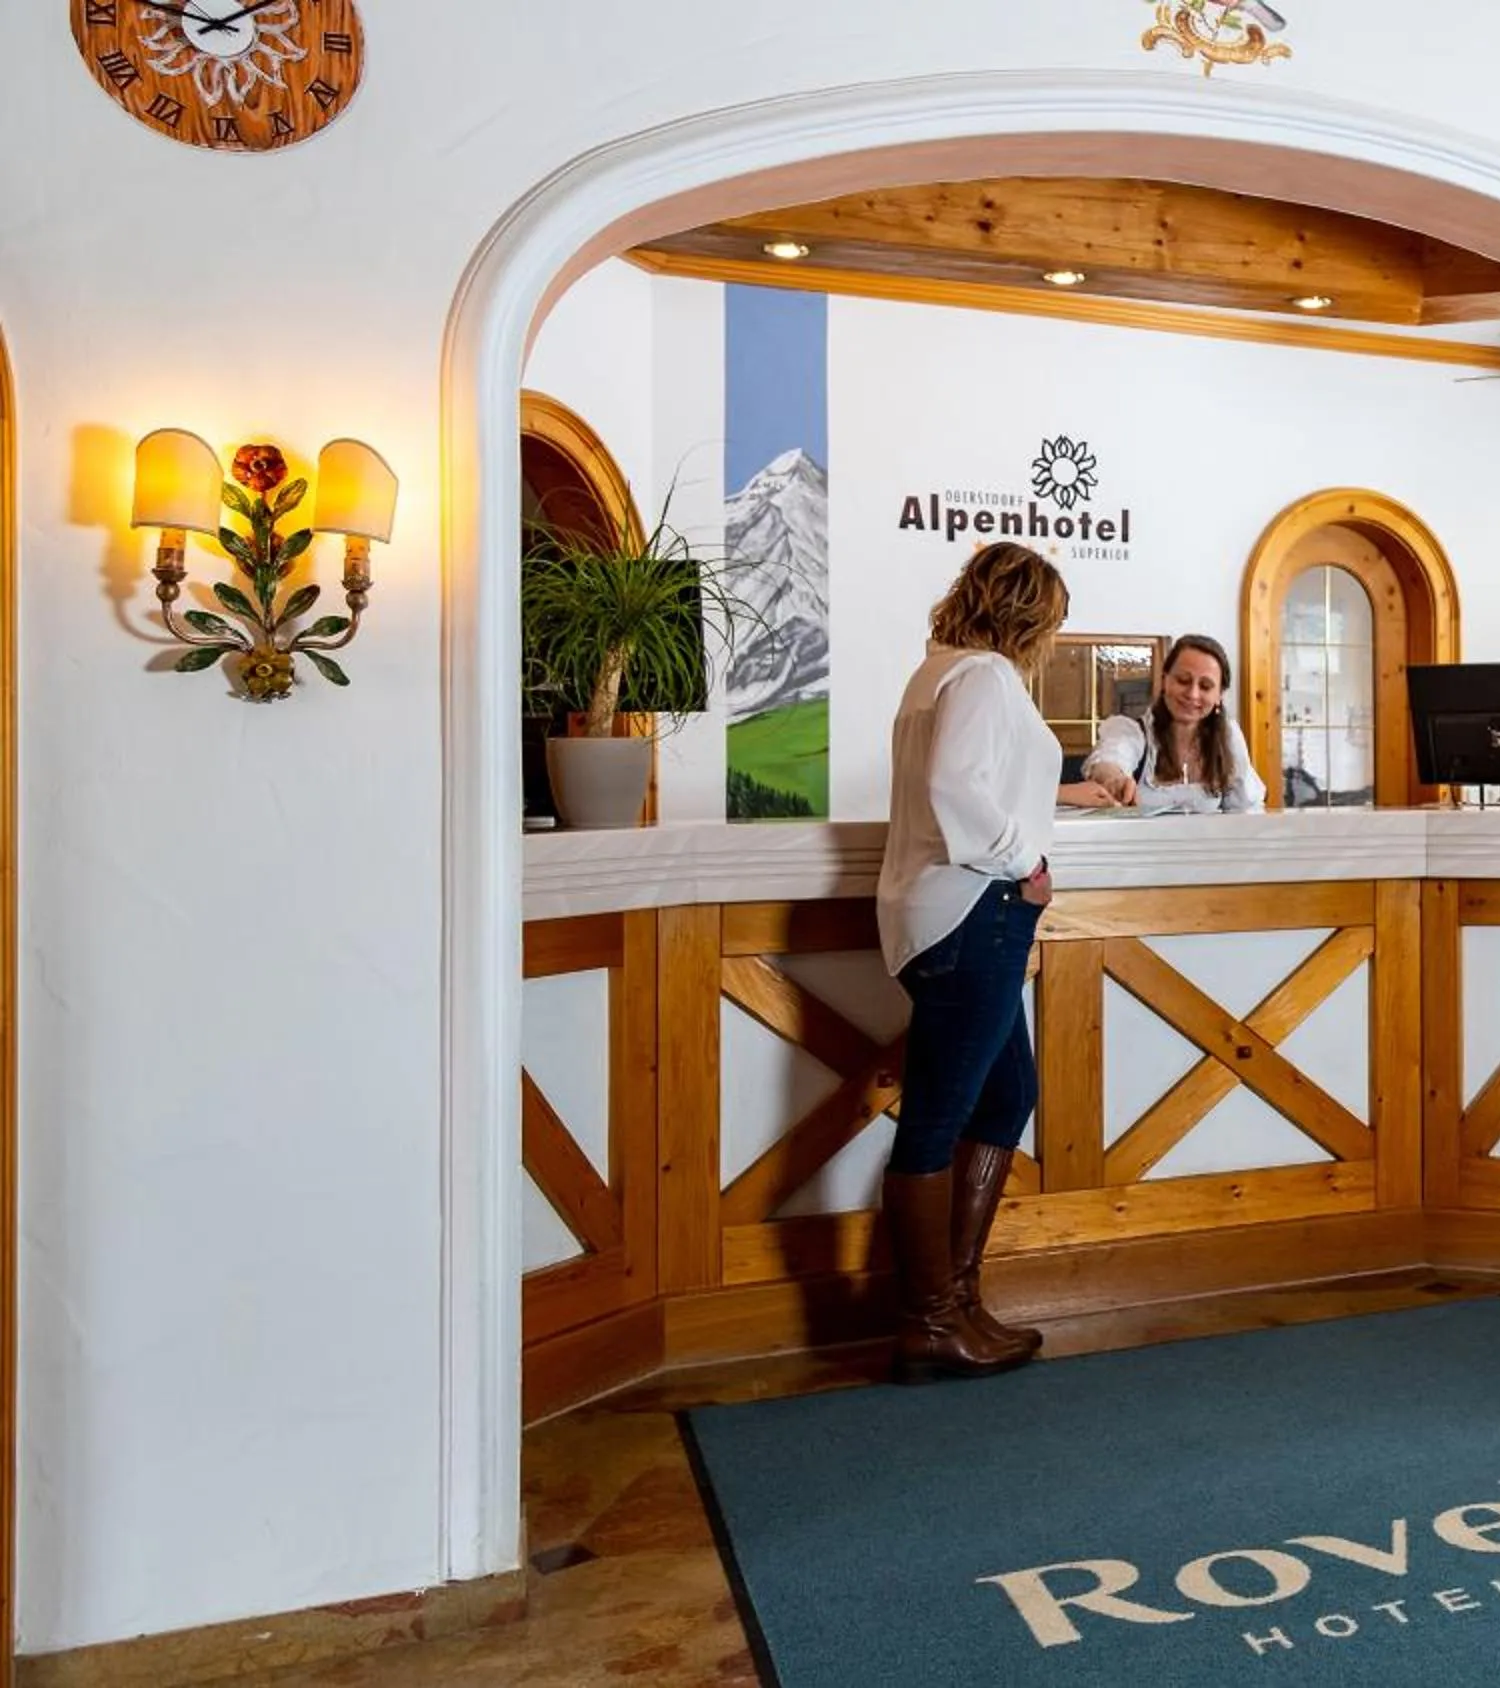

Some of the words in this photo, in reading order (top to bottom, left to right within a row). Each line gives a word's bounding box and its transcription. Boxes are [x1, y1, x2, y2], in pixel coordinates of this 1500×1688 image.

[323, 31, 352, 53] III
[944, 489, 1024, 507] OBERSTDORF
[898, 493, 1130, 543] Alpenhotel
[1071, 546, 1130, 561] SUPERIOR
